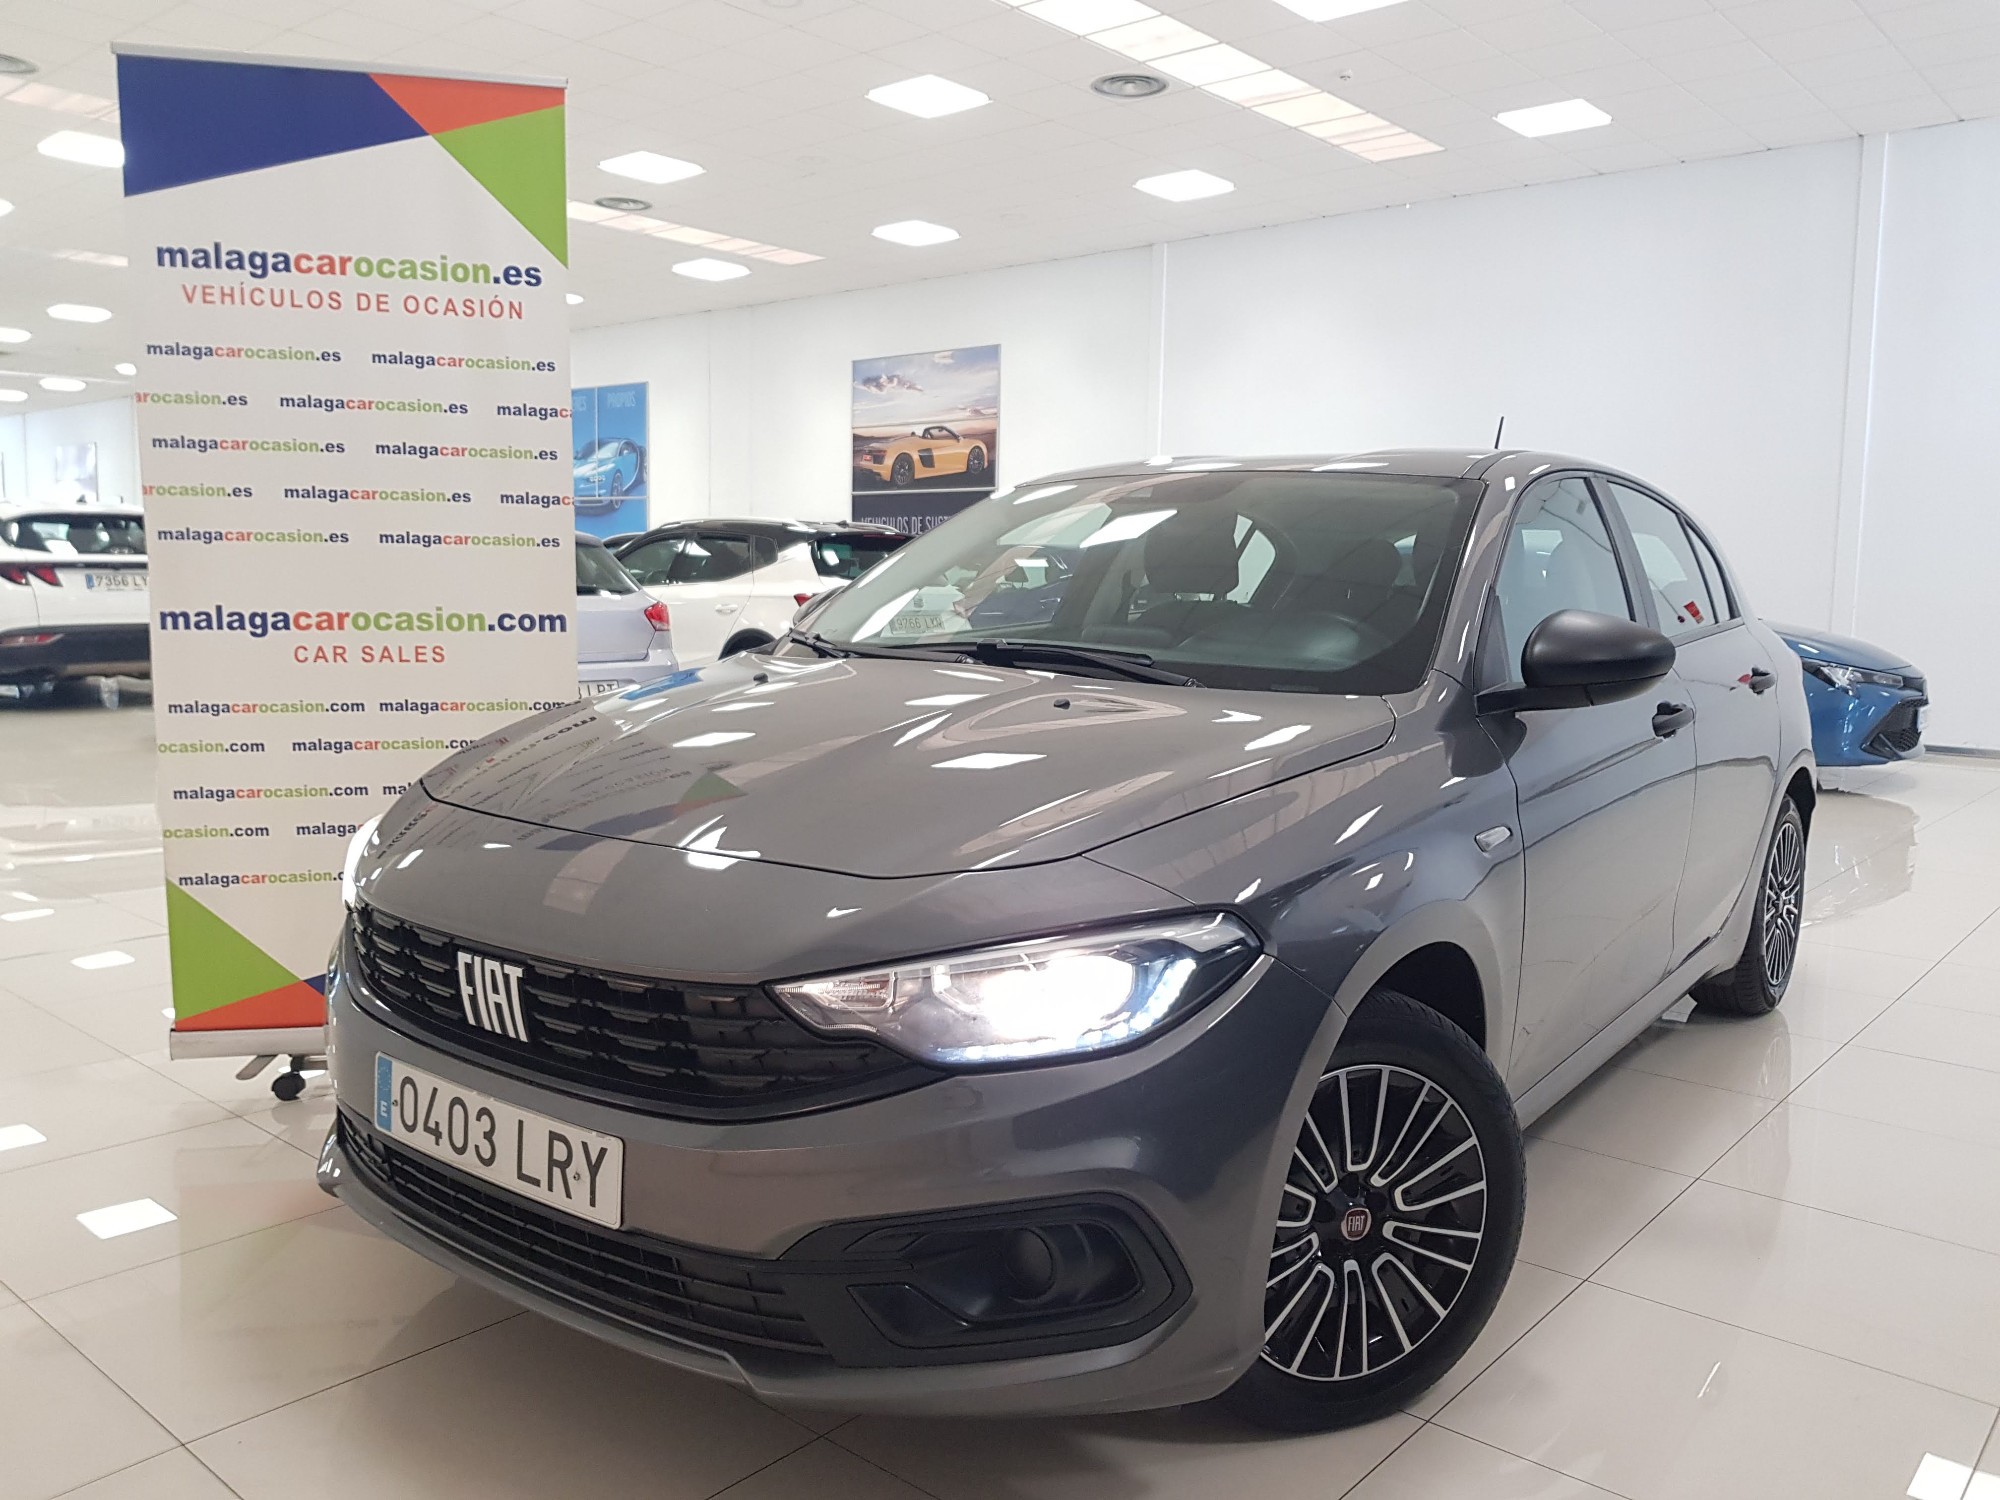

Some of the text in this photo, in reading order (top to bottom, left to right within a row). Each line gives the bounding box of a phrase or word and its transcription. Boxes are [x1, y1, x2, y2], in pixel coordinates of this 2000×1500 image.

[156, 241, 542, 288] malagacarocasion.es
[181, 281, 524, 320] VEHÍCULOS DE OCASIÓN
[146, 341, 341, 363] malagacarocasion.es
[371, 349, 556, 373] malagacarocasion.es
[279, 393, 469, 415] malagacarocasion.es
[496, 403, 572, 420] malagac
[152, 434, 345, 454] malagacarocasion.es
[375, 440, 558, 461] malagacarocasion.es
[284, 484, 472, 505] malagacarocasion.es
[500, 491, 575, 508] malagac
[911, 517, 923, 534] DE
[157, 526, 349, 547] malagacarocasion.es
[379, 530, 561, 550] malagacarocasion.es
[159, 604, 567, 638] malagacarocasion.com
[294, 644, 446, 664] CAR SALES
[168, 698, 365, 717] malagacarocasion.com
[158, 739, 265, 755] ocasion.com
[292, 736, 476, 755] malagacarocasion.co
[173, 782, 369, 802] malagacarocasion.com
[163, 822, 269, 839] ocasion.com
[457, 950, 529, 1043] FIAT
[380, 1076, 609, 1208] E 0403 LRY
[1347, 1215, 1365, 1231] FIAT
